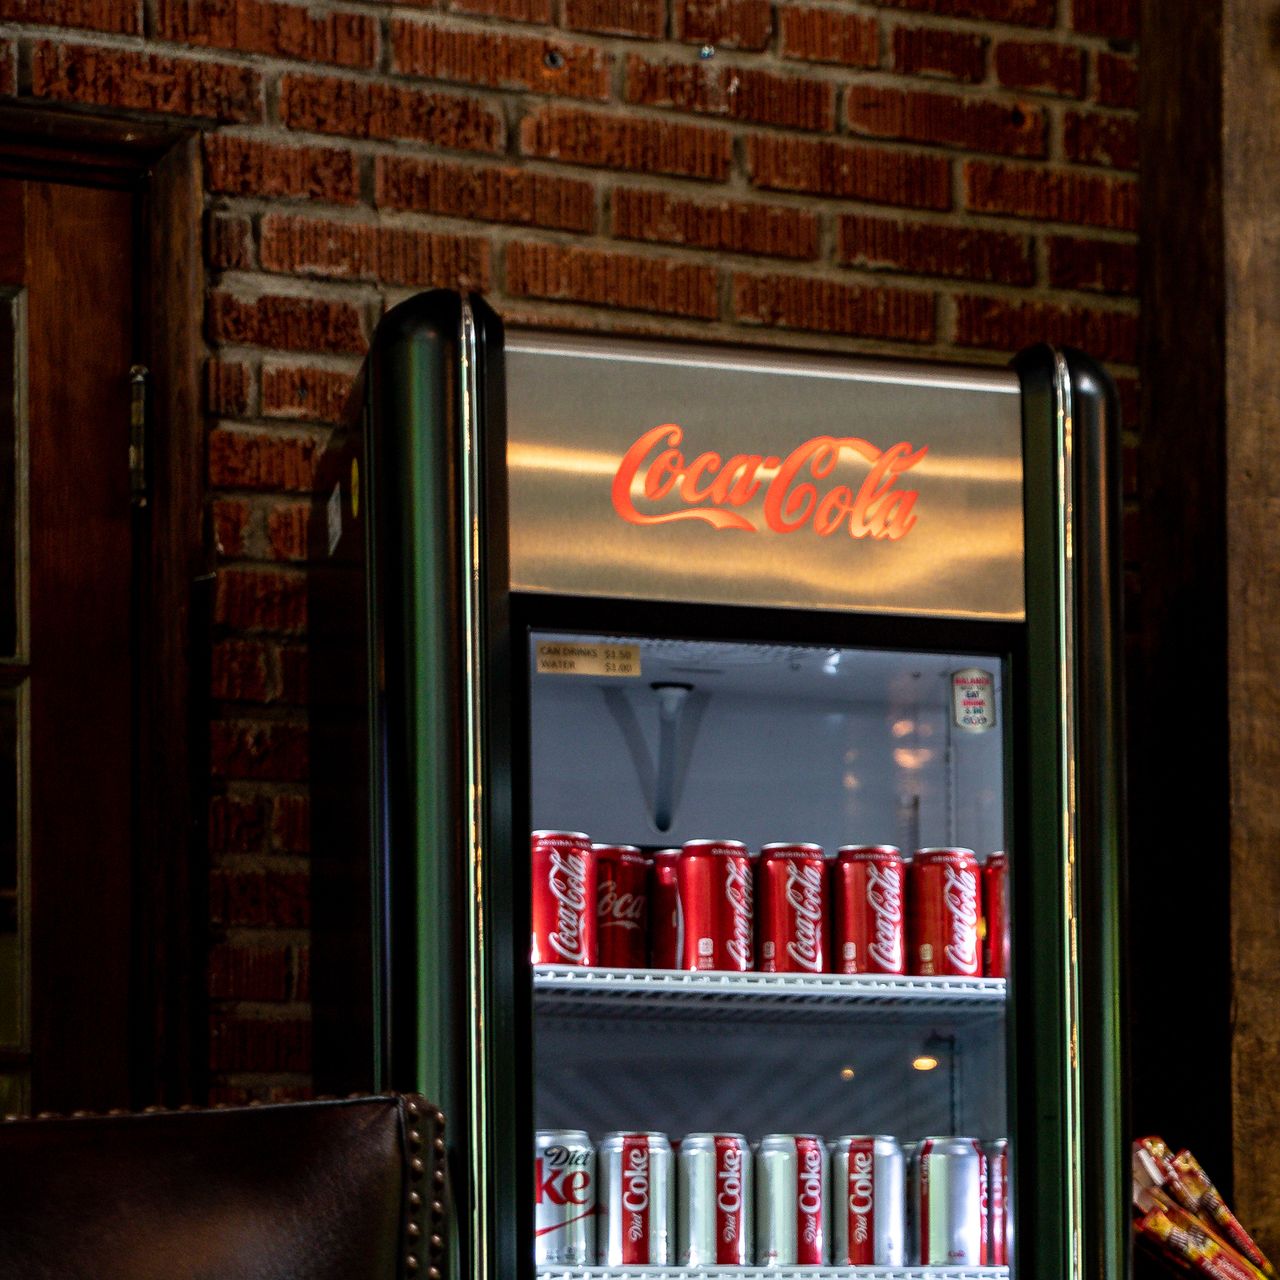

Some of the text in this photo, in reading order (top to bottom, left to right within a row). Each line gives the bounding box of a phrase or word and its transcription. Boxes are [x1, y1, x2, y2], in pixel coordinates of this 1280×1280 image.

[611, 423, 928, 540] Coca-Cola
[548, 847, 586, 961] Coca-Cola
[726, 857, 754, 969] Coca-Cola
[786, 859, 822, 971] Coca-Cola
[867, 862, 901, 972] Coca-Cola
[945, 863, 977, 974] Coca-Cola
[536, 1158, 590, 1205] ke
[544, 1145, 590, 1166] Diet
[623, 1149, 649, 1242] Diet Coke
[717, 1151, 741, 1243] Diet Coke
[800, 1150, 821, 1214] Coke
[850, 1152, 873, 1244] Diet Coke
